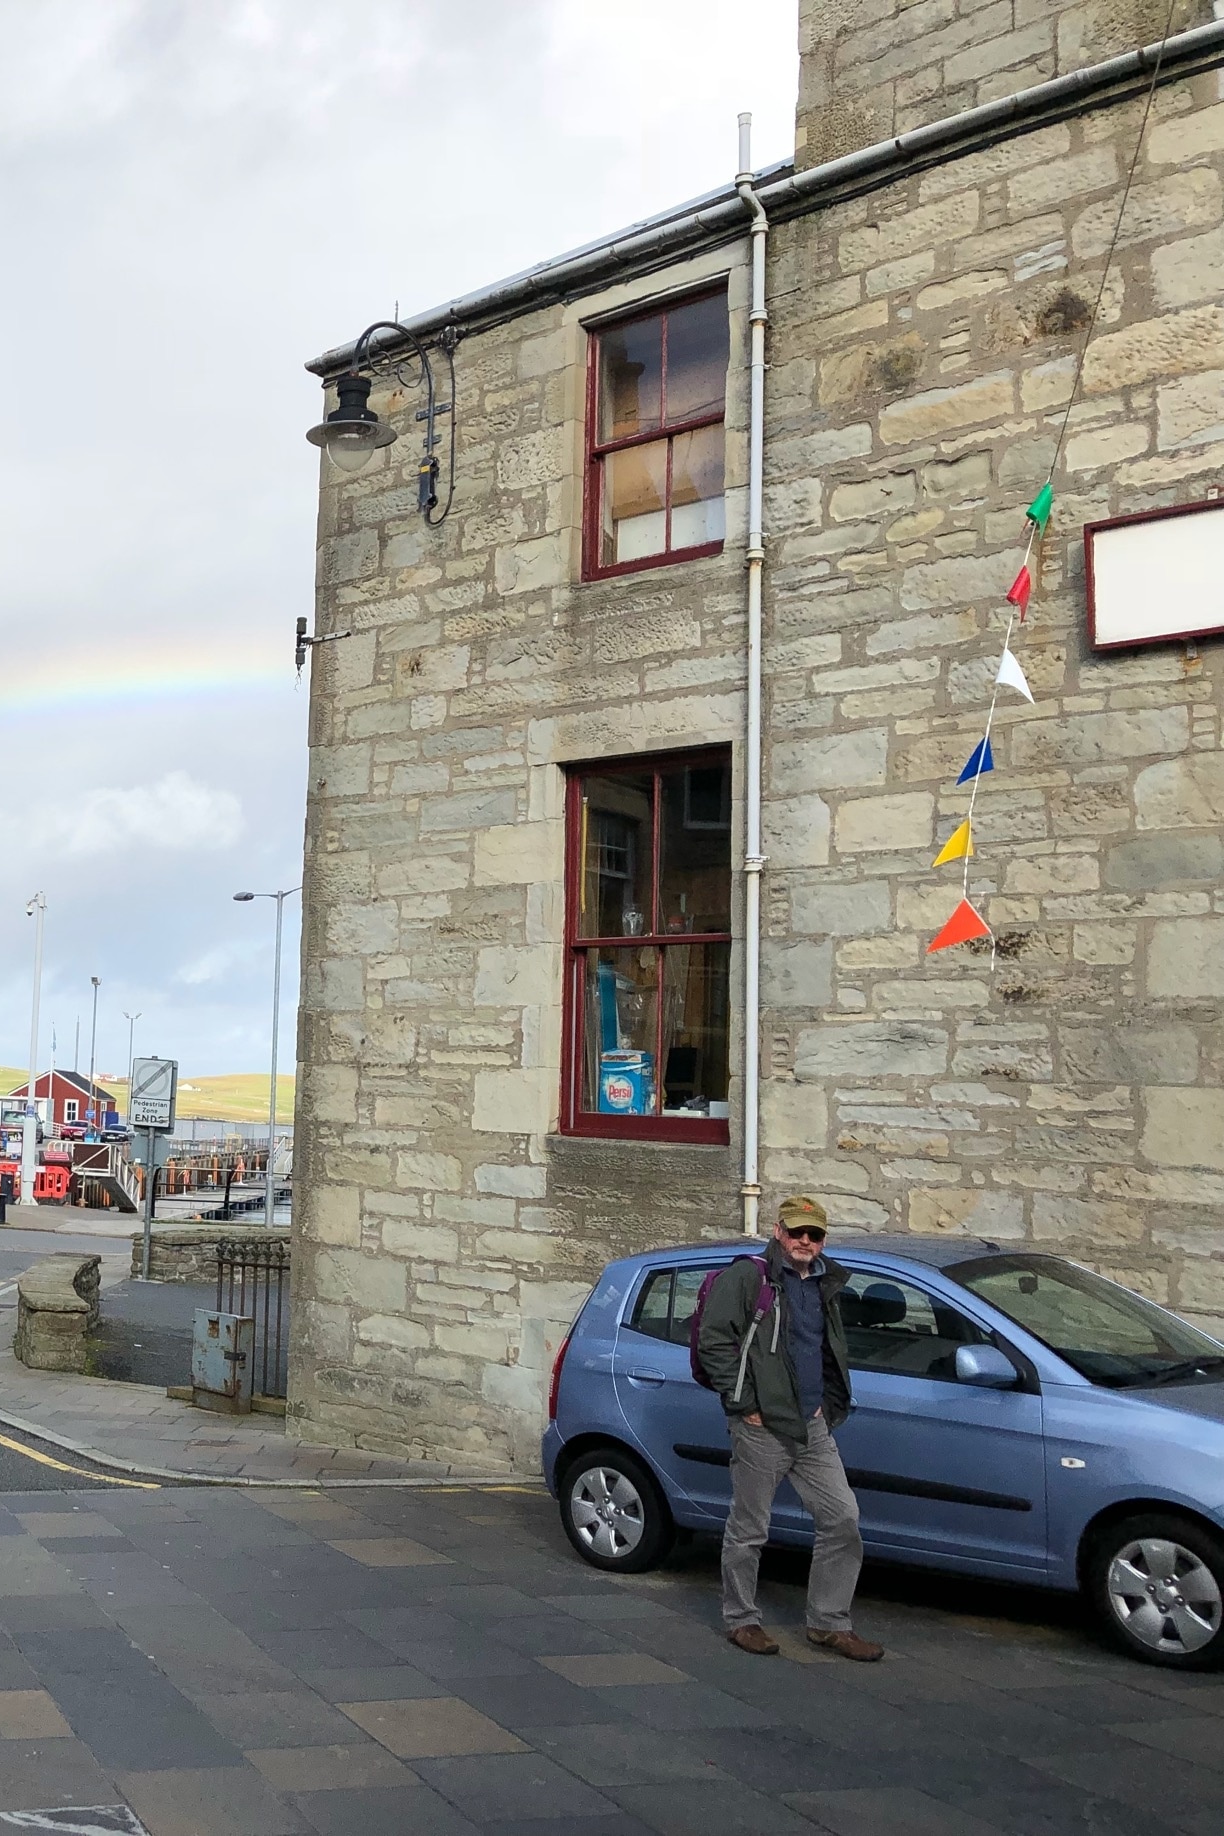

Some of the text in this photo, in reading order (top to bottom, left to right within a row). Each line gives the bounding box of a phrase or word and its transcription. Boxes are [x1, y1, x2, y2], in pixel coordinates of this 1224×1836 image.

[608, 1084, 633, 1101] Persil
[133, 1100, 167, 1108] Pedestrian
[135, 1113, 165, 1124] ENDS
